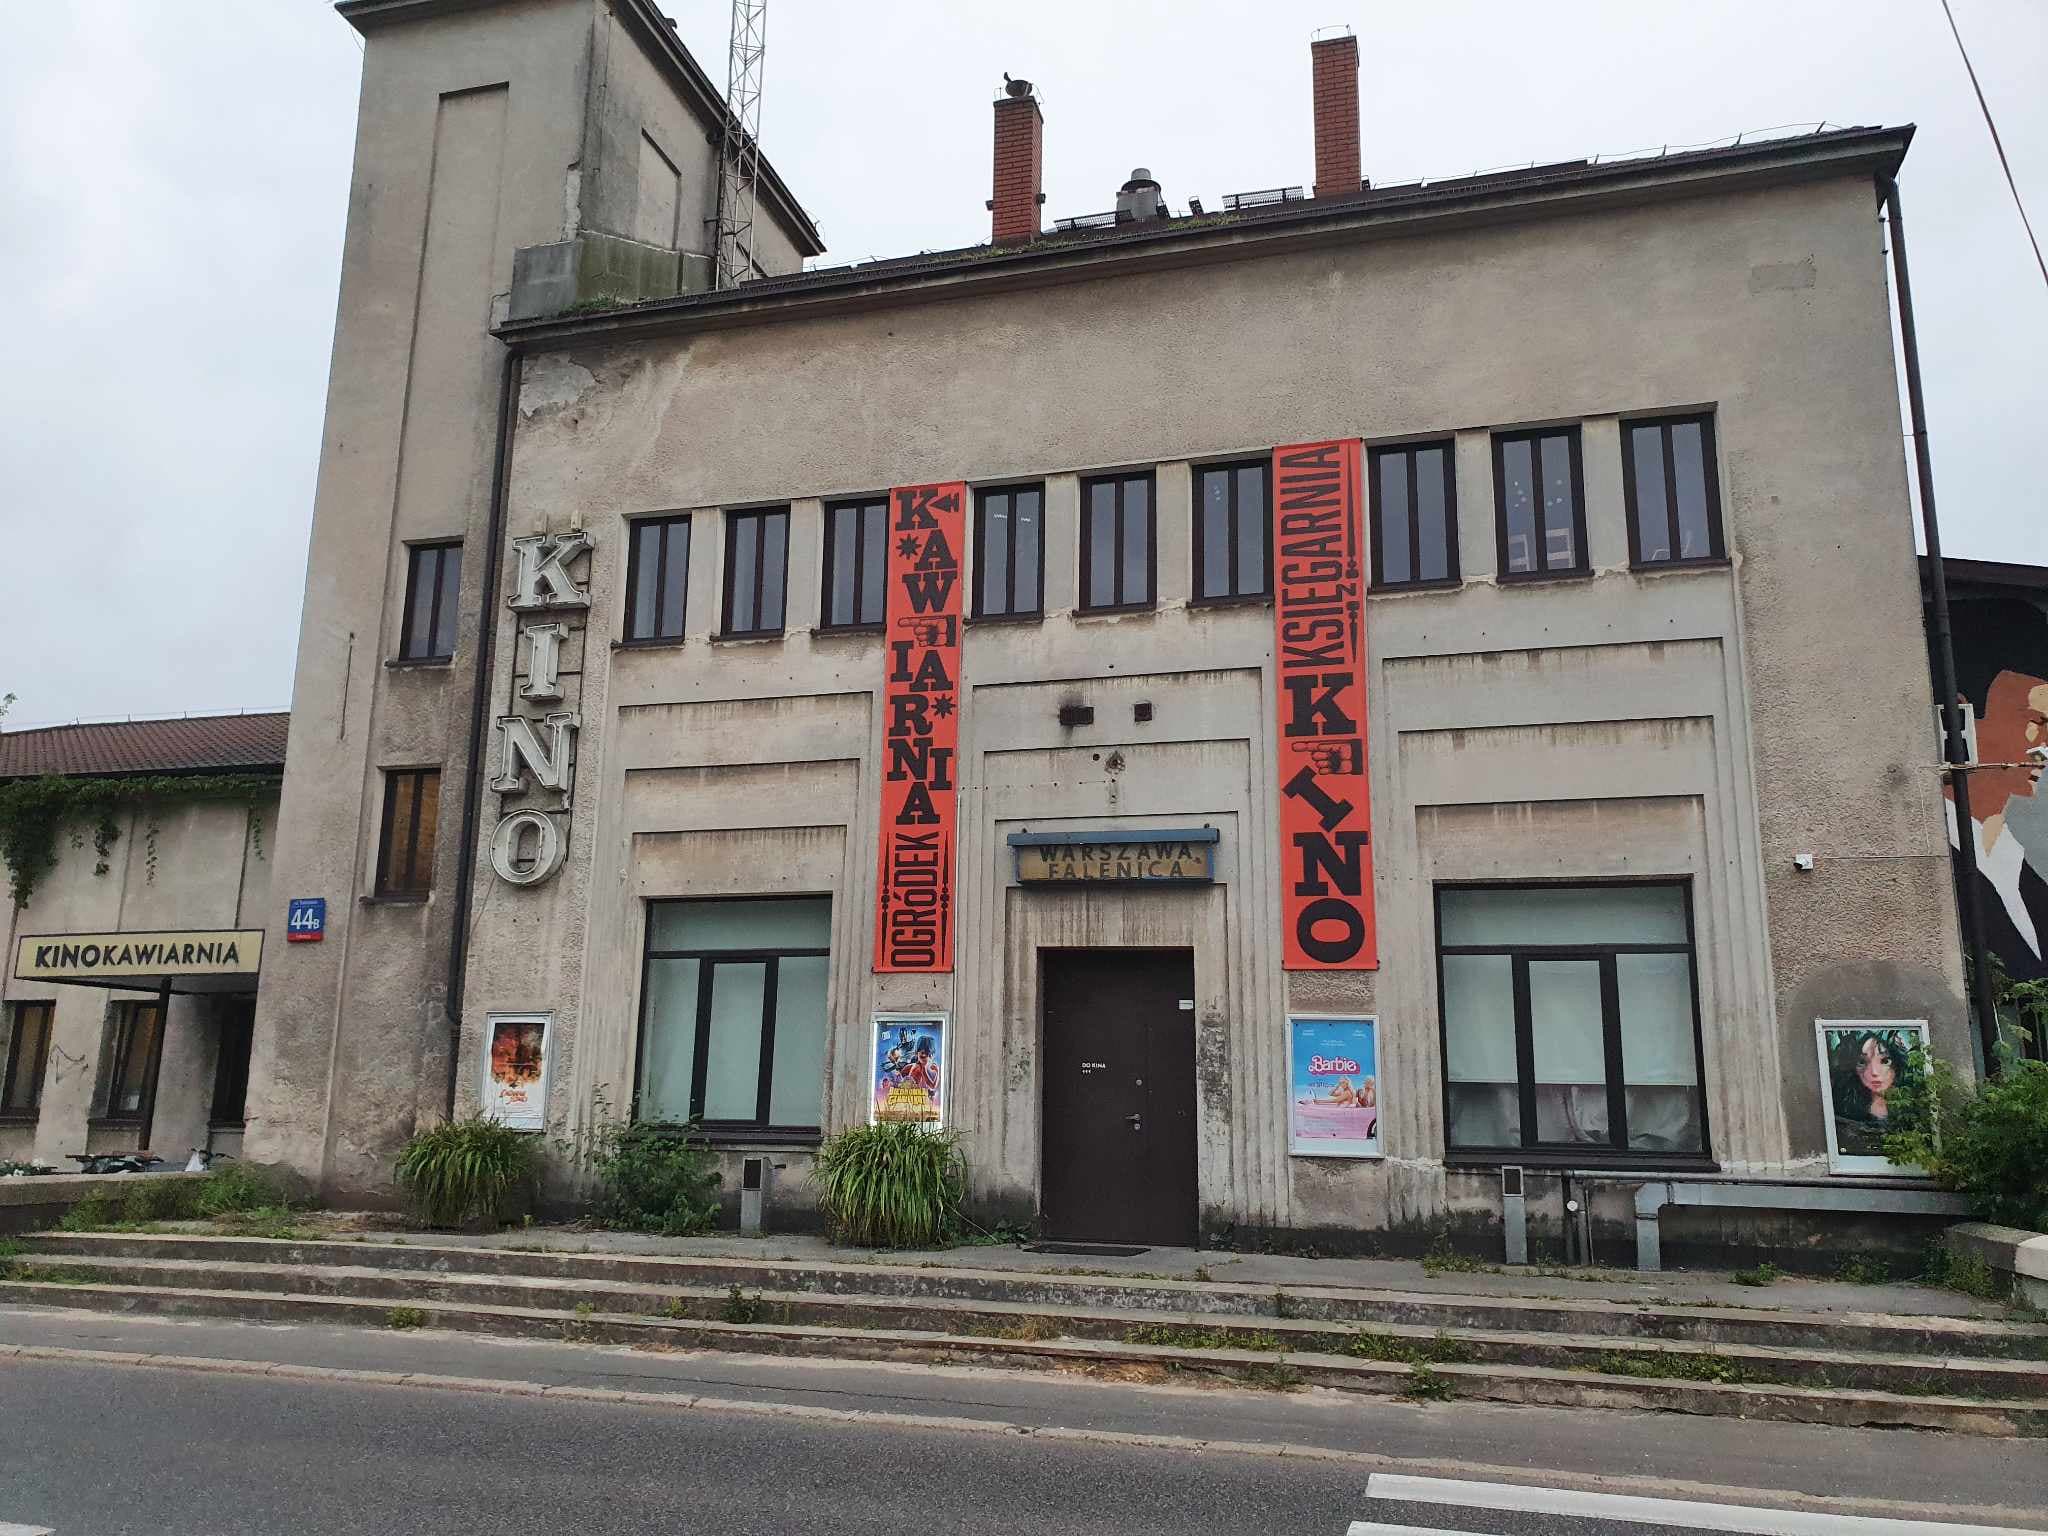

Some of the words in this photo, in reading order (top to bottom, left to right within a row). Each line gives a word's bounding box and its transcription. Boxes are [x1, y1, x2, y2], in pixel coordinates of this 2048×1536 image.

[489, 531, 595, 887] KINO
[887, 490, 958, 826] KAWIARNIA
[890, 832, 940, 968] OGRÓDEK
[1048, 861, 1184, 880] FALENICA
[1284, 672, 1369, 964] KINO
[1308, 1055, 1358, 1073] Barbie
